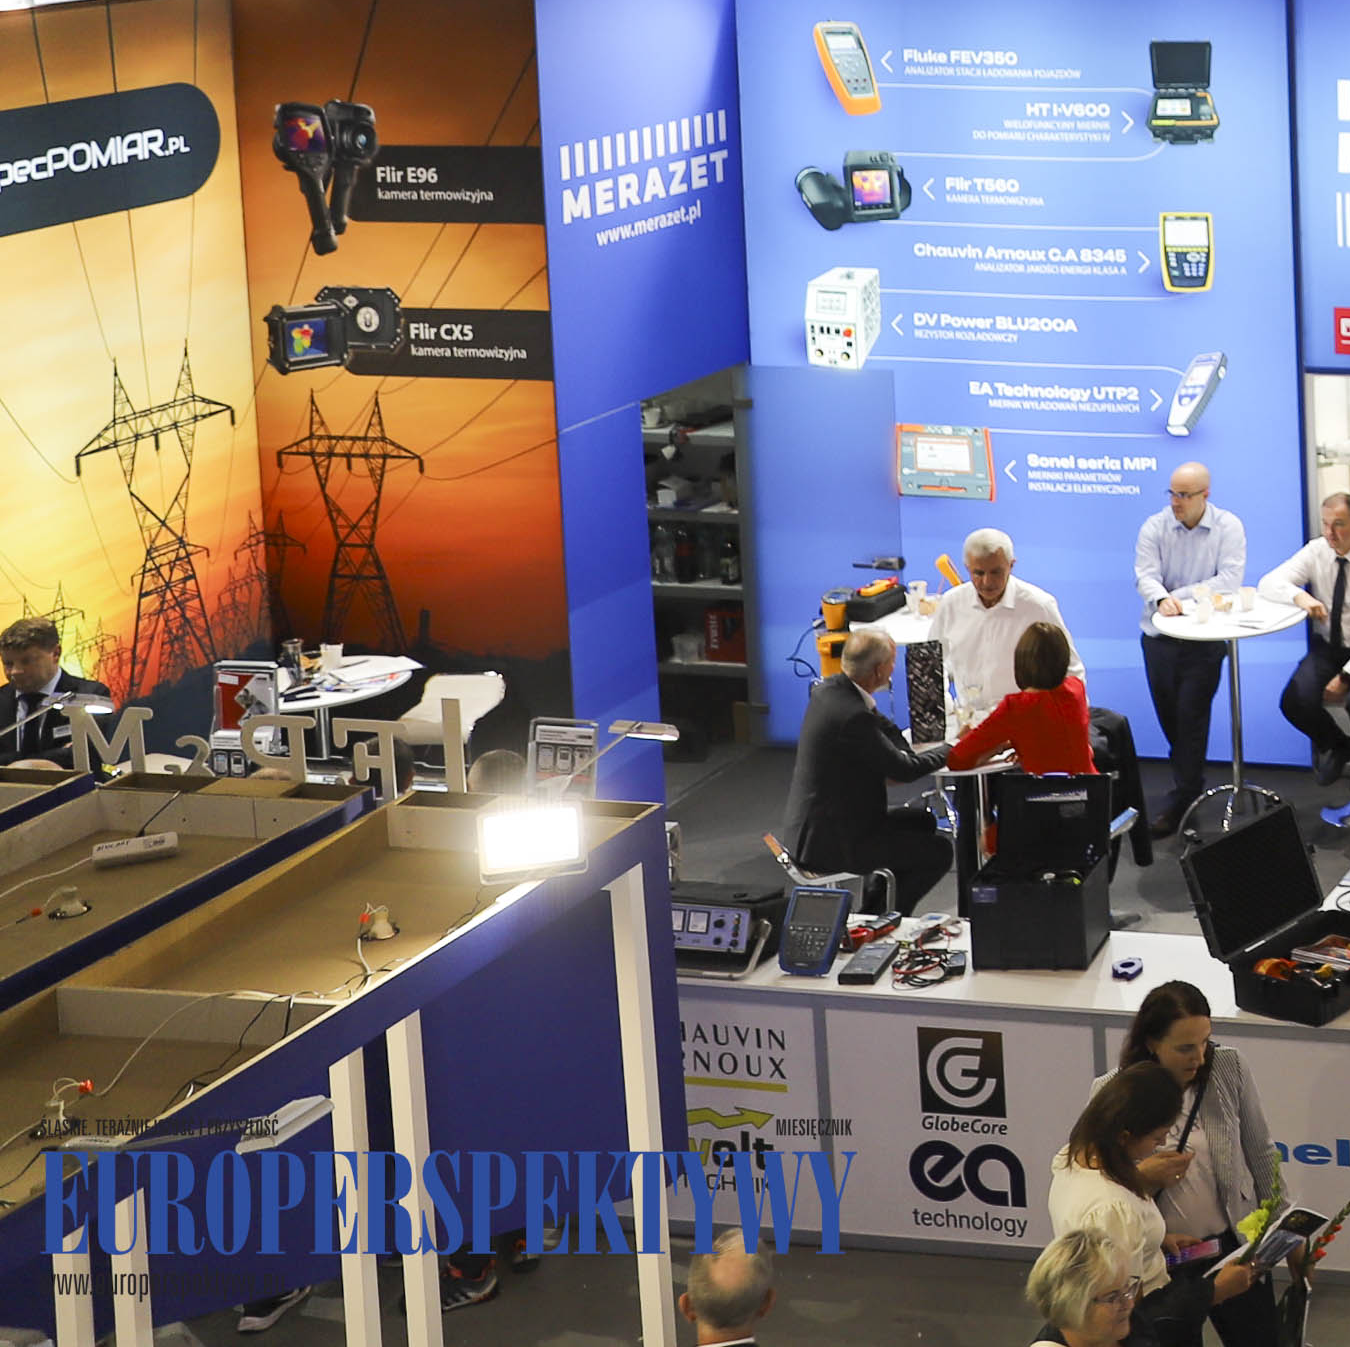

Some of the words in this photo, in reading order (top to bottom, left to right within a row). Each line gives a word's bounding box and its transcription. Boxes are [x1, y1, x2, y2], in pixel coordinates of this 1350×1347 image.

[903, 47, 948, 64] Fluke
[1025, 103, 1050, 117] HT
[0, 128, 191, 194] pecPOMIAR.PL
[376, 166, 404, 184] Flir
[406, 166, 438, 184] E96
[944, 176, 972, 191] Flir
[377, 188, 418, 202] kamera
[419, 188, 494, 204] termowizyjna
[562, 149, 728, 225] MERAZET
[596, 199, 702, 246] www.merazet.pl
[913, 242, 983, 259] Chauvin
[985, 246, 1046, 262] Arnoux
[409, 322, 437, 340] Flir
[439, 323, 474, 341] CX5
[913, 312, 938, 327] DV
[940, 313, 993, 329] Power
[995, 316, 1079, 333] BLU200A
[410, 345, 452, 358] kamera
[453, 346, 527, 362] termowizyjna
[969, 381, 993, 396] EA
[994, 382, 1091, 402] Technology
[1093, 386, 1140, 401] UTP2
[1027, 453, 1075, 469] Sonel
[1077, 455, 1121, 470] seria
[1123, 456, 1158, 471] MPI
[682, 1021, 786, 1051] AUVIN
[684, 1049, 787, 1080] NOUX
[921, 1115, 1008, 1135] GlobeCore
[909, 1140, 1028, 1208] ea
[912, 1208, 1028, 1238] technology
